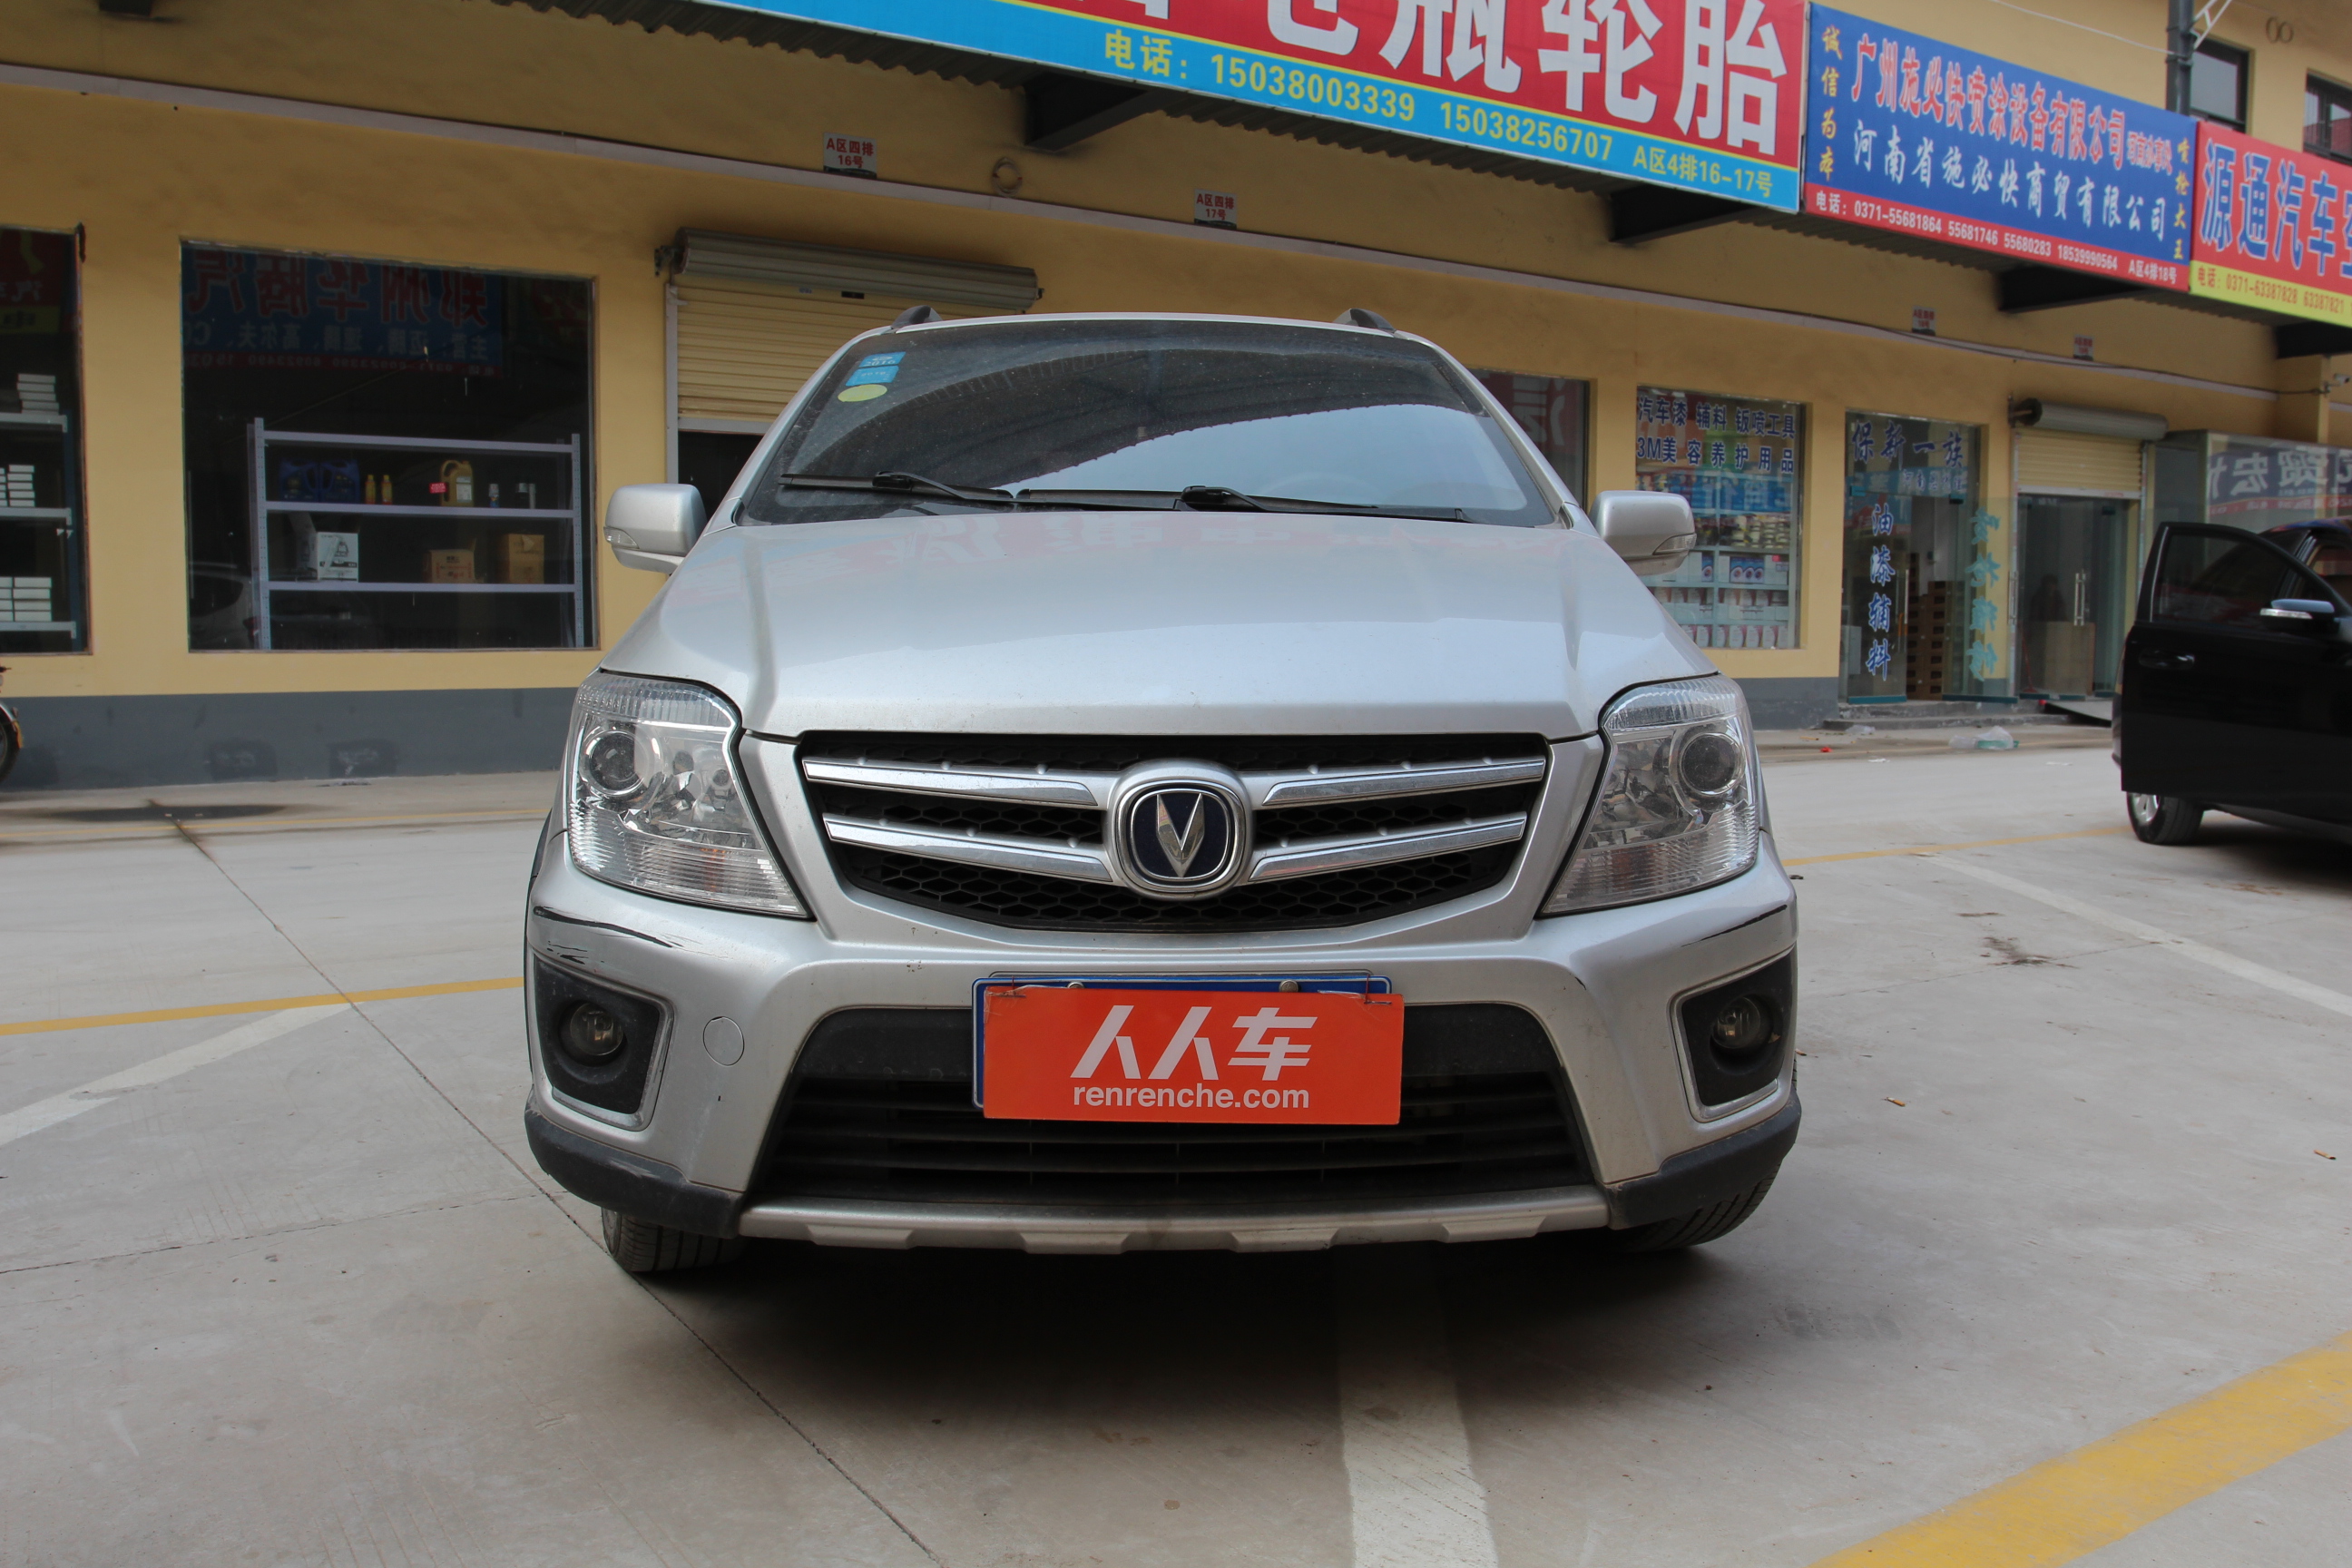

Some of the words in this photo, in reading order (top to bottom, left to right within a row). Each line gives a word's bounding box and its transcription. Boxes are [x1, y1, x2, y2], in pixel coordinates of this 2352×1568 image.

[826, 138, 874, 157] A区四排
[1211, 54, 1415, 122] 15038003339
[1440, 102, 1613, 161] 15038256707
[1632, 145, 1773, 198] A区4排16-17号
[838, 155, 863, 169] 16号
[1854, 119, 2167, 242] 河南省施必快商贸有限公司
[1196, 193, 1234, 210] A区四排
[1206, 209, 1226, 220] 17号
[1854, 200, 1942, 234] 0371-55681864
[1947, 220, 1999, 245] 55681746
[1638, 396, 1688, 426] 汽车漆
[1696, 402, 1728, 431] 辅料
[1735, 407, 1796, 440] 钣喷工具
[1866, 503, 1896, 681] 油漆辅料
[1070, 1004, 1318, 1081] 人人车
[1073, 1082, 1309, 1109] renrenche.com
